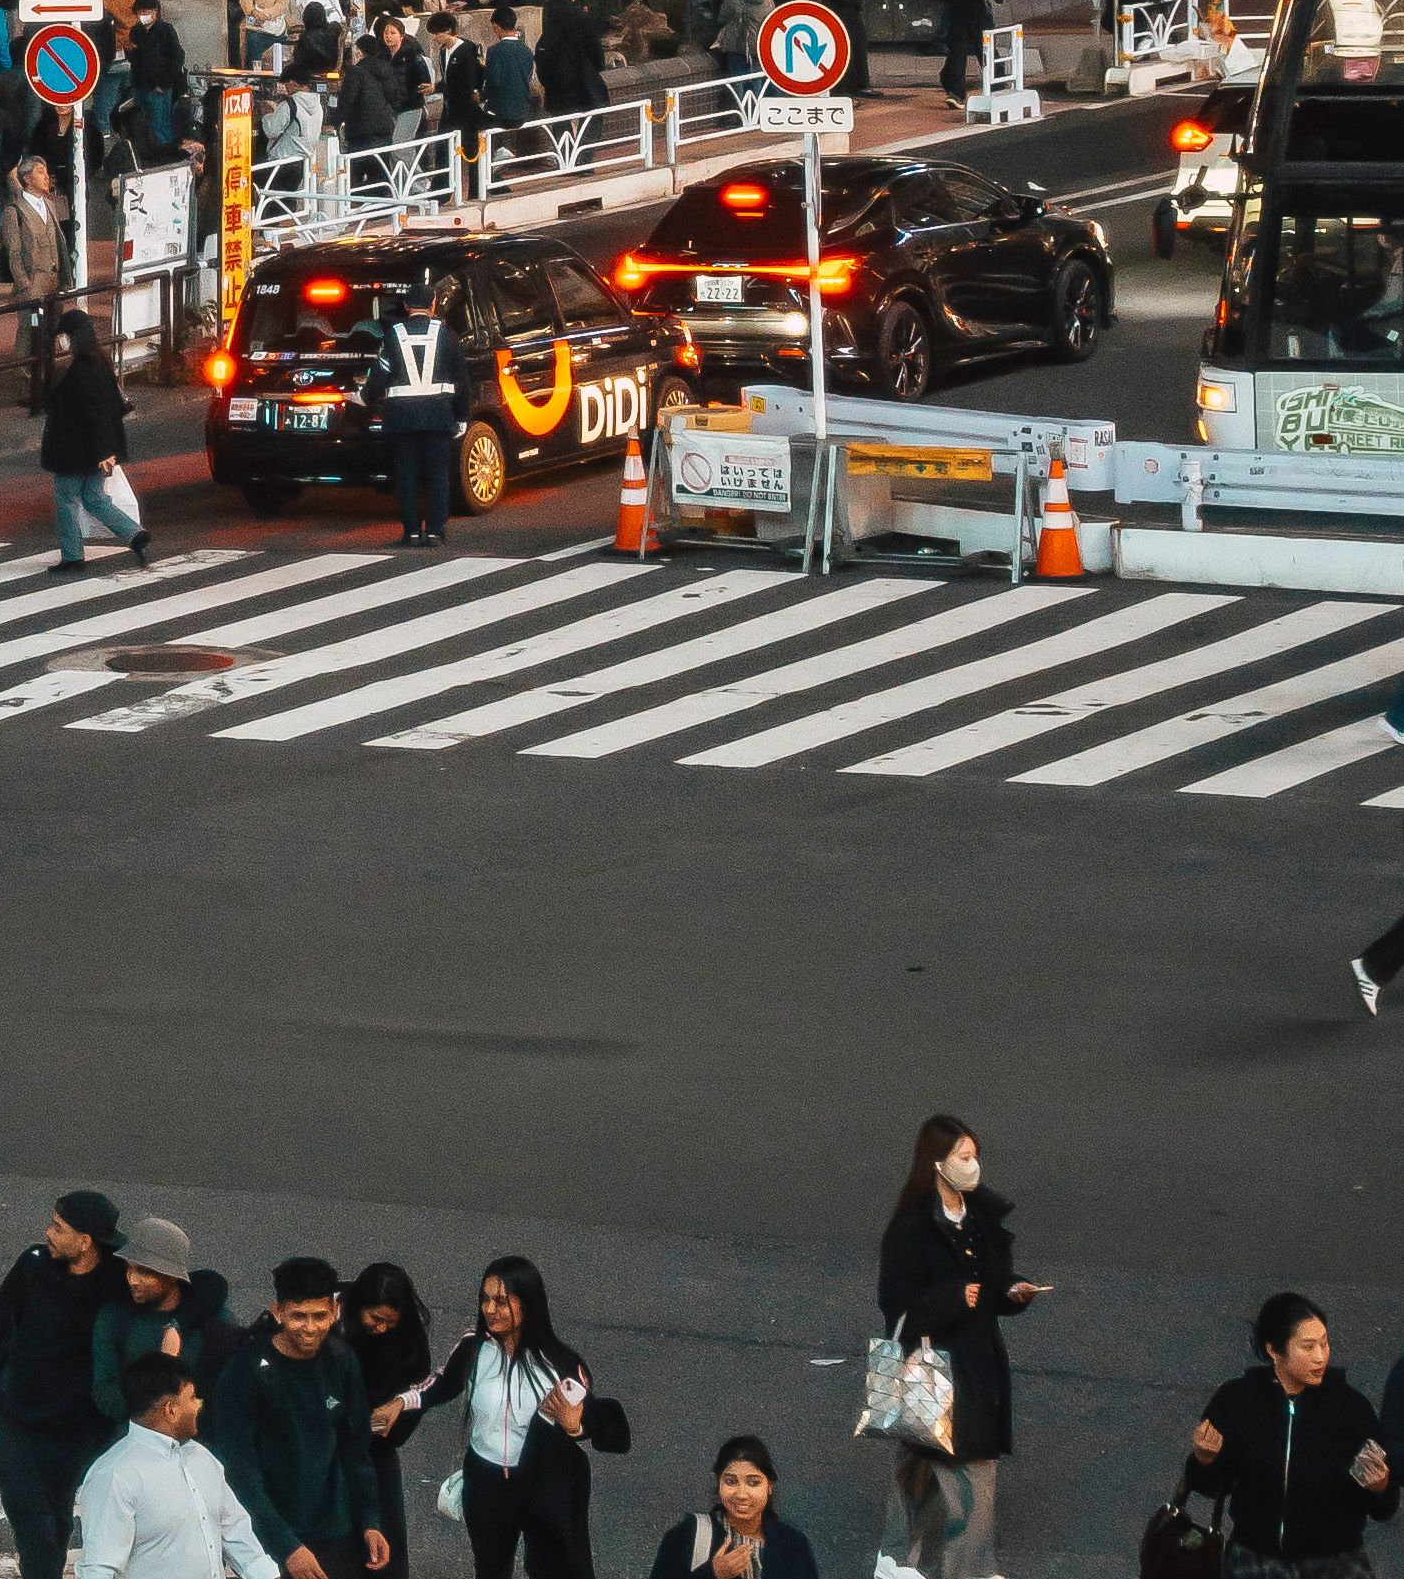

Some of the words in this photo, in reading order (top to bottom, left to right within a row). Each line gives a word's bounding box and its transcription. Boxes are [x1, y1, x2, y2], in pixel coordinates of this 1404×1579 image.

[767, 106, 845, 126] ここまで
[579, 365, 647, 444] DiDi
[720, 464, 783, 479] はいっては
[720, 477, 784, 491] いけません
